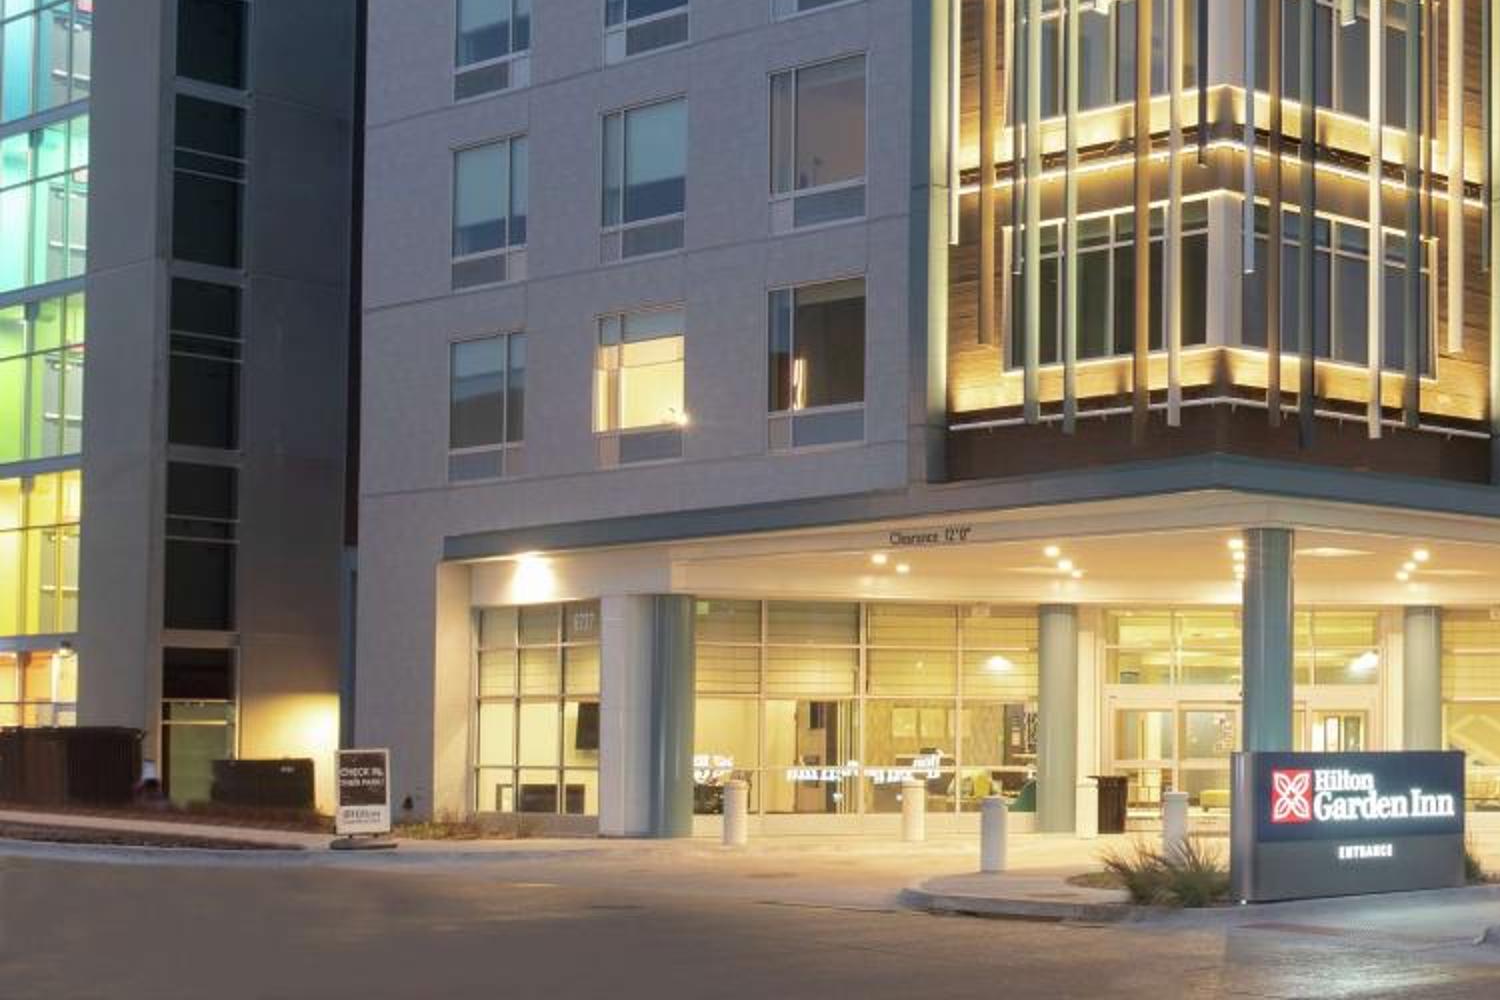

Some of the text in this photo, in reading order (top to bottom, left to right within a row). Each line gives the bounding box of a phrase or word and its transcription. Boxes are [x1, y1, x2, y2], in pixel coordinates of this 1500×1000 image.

[1314, 768, 1375, 791] Hilton
[1314, 788, 1455, 821] Garden Inn
[1339, 844, 1393, 859] ENTRANCE
